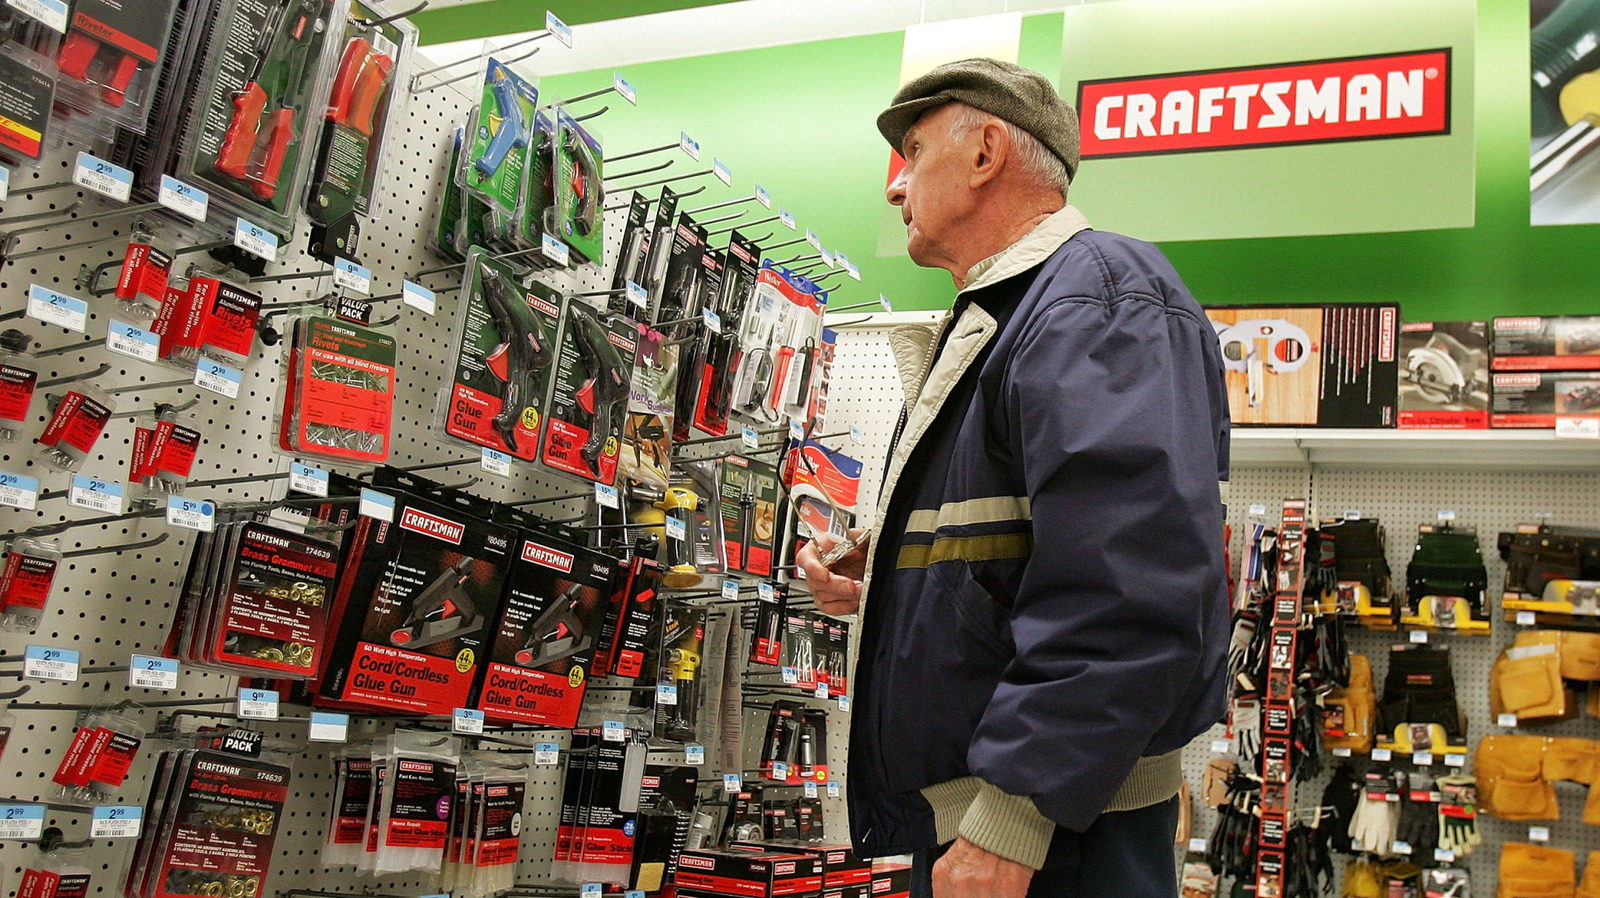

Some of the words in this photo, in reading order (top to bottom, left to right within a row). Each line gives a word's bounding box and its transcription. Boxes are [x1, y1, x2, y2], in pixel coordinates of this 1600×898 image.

[77, 14, 114, 38] Riveter
[1094, 69, 1424, 140] CRAFTSMAN
[96, 163, 113, 174] 299
[177, 184, 191, 194] 299
[50, 294, 66, 305] 299
[222, 289, 256, 307] CRAFTSMAN
[341, 298, 368, 311] VALUE
[219, 299, 244, 312] Aluminum
[528, 297, 557, 315] CRAFTSMAN
[215, 306, 252, 327] Rivets
[341, 306, 363, 320] PACK
[126, 327, 142, 338] 299
[312, 336, 340, 351] Rivets
[211, 366, 226, 376] 299
[335, 355, 347, 363] with
[347, 358, 355, 366] all
[355, 360, 369, 369] blind
[369, 363, 390, 373] riveters
[2, 368, 31, 378] CRAFTSMAN
[456, 400, 482, 418] Glue
[454, 413, 477, 430] Gun
[551, 433, 572, 449] Glue
[549, 445, 568, 460] Gun
[0, 474, 17, 485] 299
[89, 480, 105, 491] 299
[182, 501, 197, 511] 599
[405, 513, 461, 539] CRAFTSMAN
[248, 531, 290, 548] CRAFTSMAN
[241, 547, 269, 561] Brass
[272, 555, 311, 572] Grommet
[313, 567, 327, 575] Kit
[526, 546, 571, 568] CRAFTSMAN
[43, 650, 61, 661] 299
[385, 649, 397, 657] High
[398, 652, 427, 662] Temperature
[147, 660, 162, 671] 299
[359, 655, 449, 684] Cord/Cordless
[354, 673, 385, 691] Glue
[390, 680, 416, 696] Gun
[490, 674, 564, 698] Cord/Cordless
[252, 692, 265, 702] 999
[486, 690, 511, 705] Glue
[515, 695, 537, 710] Gun
[225, 738, 253, 752] PACK
[197, 761, 240, 775] CRAFTSMAN
[402, 762, 432, 771] CRAFTSMAN
[190, 779, 218, 791] Brass
[221, 784, 261, 798] Grommet
[264, 792, 278, 800] Kit
[6, 808, 24, 820] 299
[109, 809, 125, 820] 299
[586, 843, 606, 851] Glue
[681, 858, 712, 867] CRAFTSMAN
